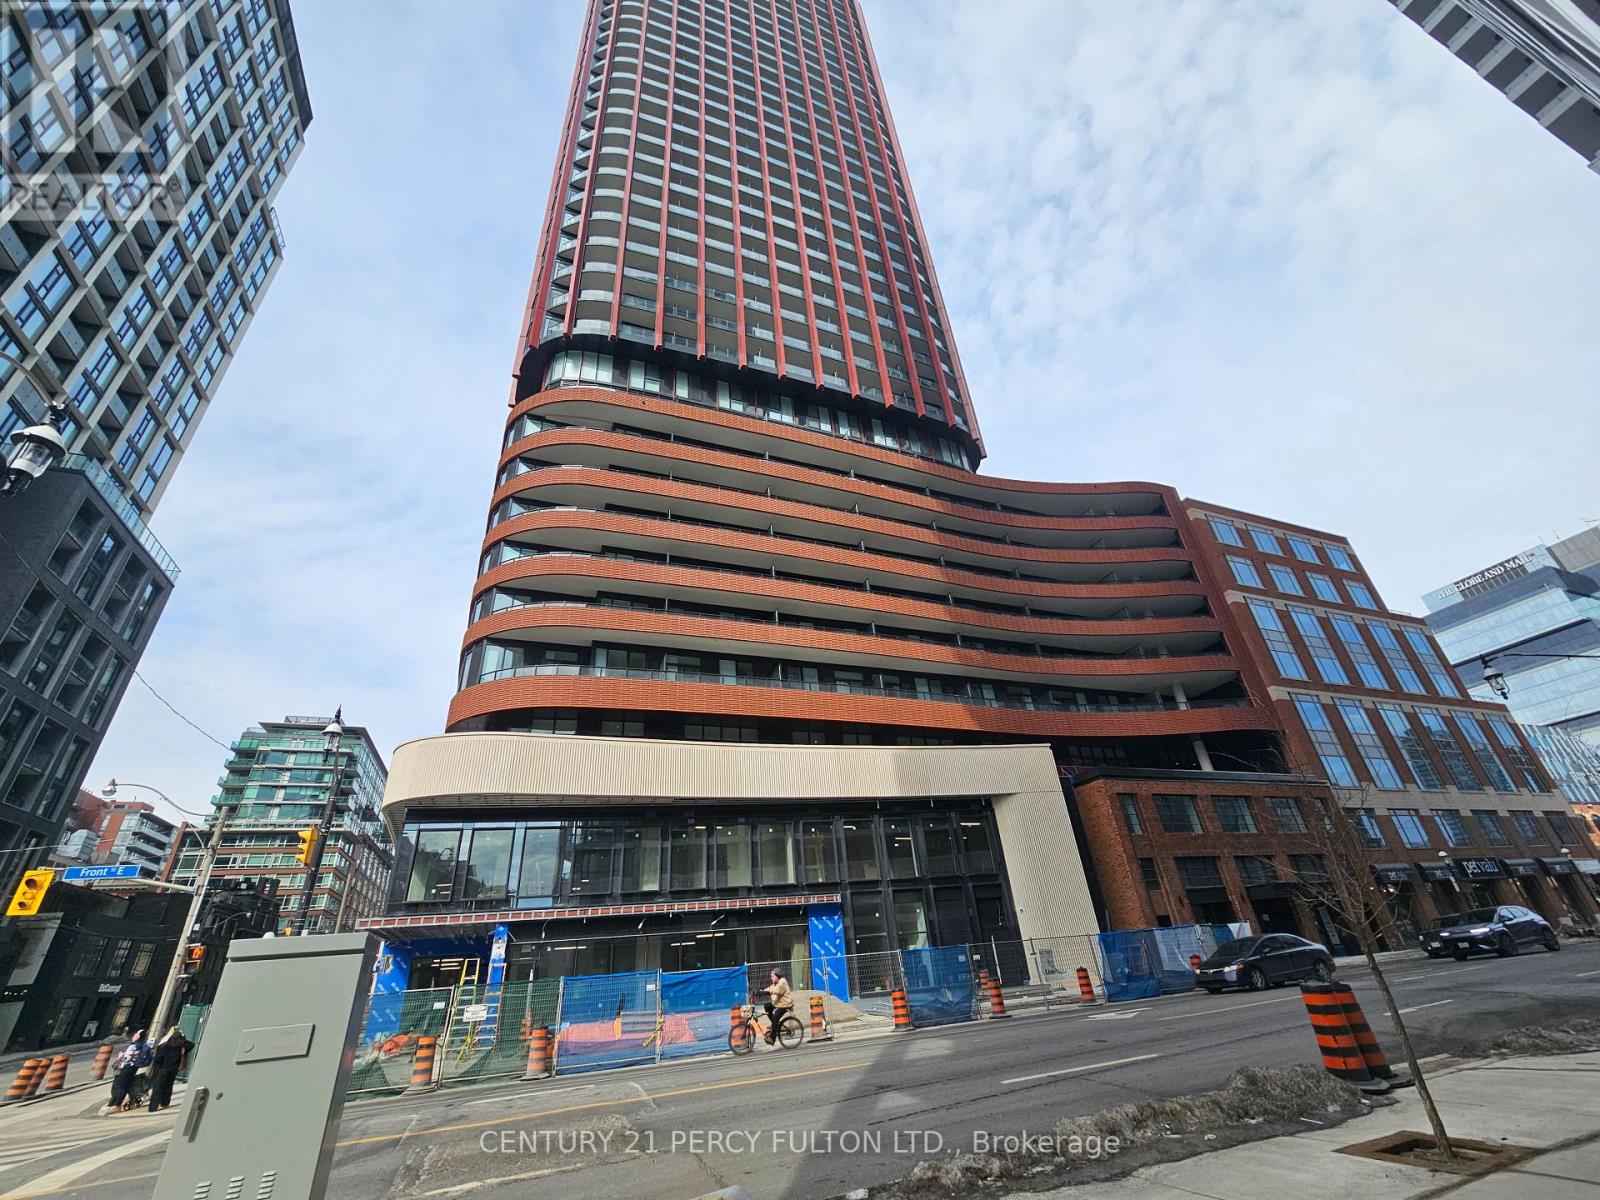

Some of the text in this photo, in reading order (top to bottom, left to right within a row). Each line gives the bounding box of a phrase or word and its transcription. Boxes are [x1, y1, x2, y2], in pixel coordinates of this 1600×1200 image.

[1436, 555, 1532, 600] THE GLOBE AND MAIL
[80, 868, 108, 876] Front
[117, 867, 125, 875] E
[1463, 861, 1481, 878] pet
[1478, 859, 1498, 873] valu
